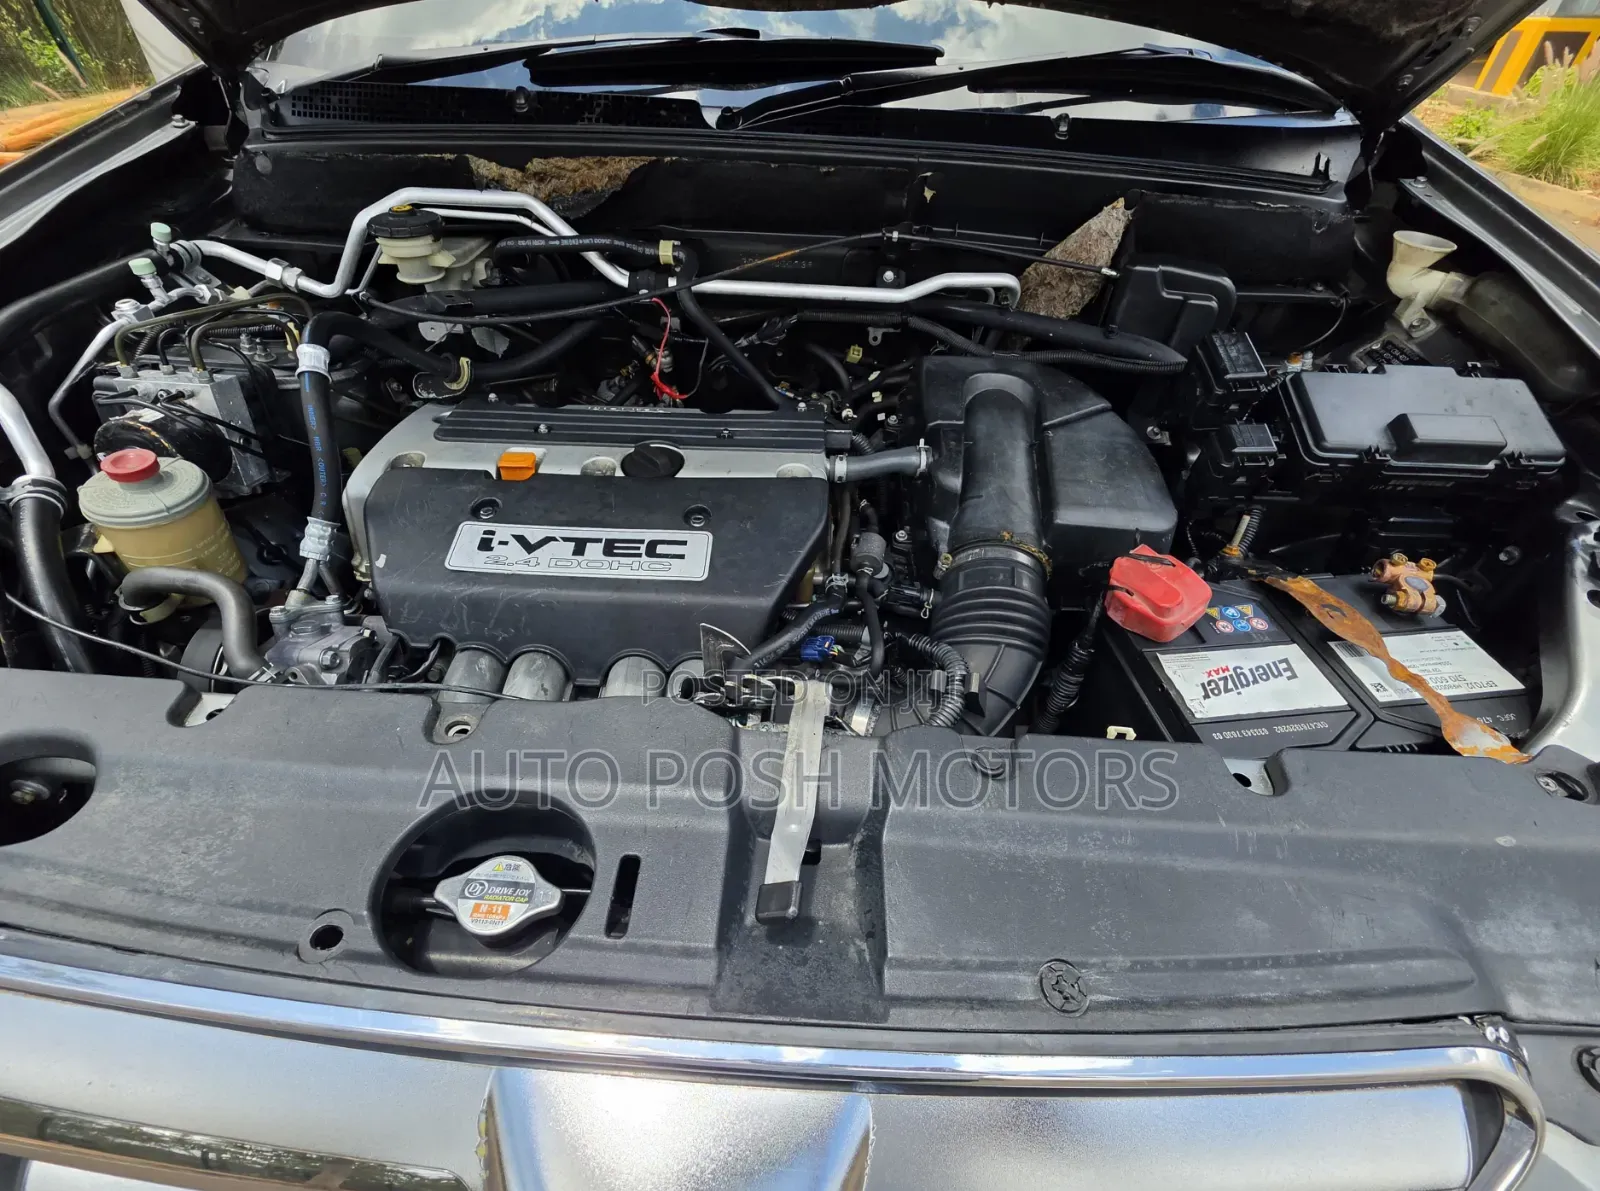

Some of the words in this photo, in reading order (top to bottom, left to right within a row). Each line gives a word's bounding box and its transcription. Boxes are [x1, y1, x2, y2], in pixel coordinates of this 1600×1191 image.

[477, 530, 688, 560] i-VTEC
[484, 554, 541, 568] 2.4
[547, 557, 673, 572] DOHC
[1200, 657, 1299, 701] Energizer
[1206, 665, 1230, 678] MAX
[488, 886, 514, 895] DRIVE
[514, 888, 532, 896] JOY
[479, 904, 504, 913] N-11
